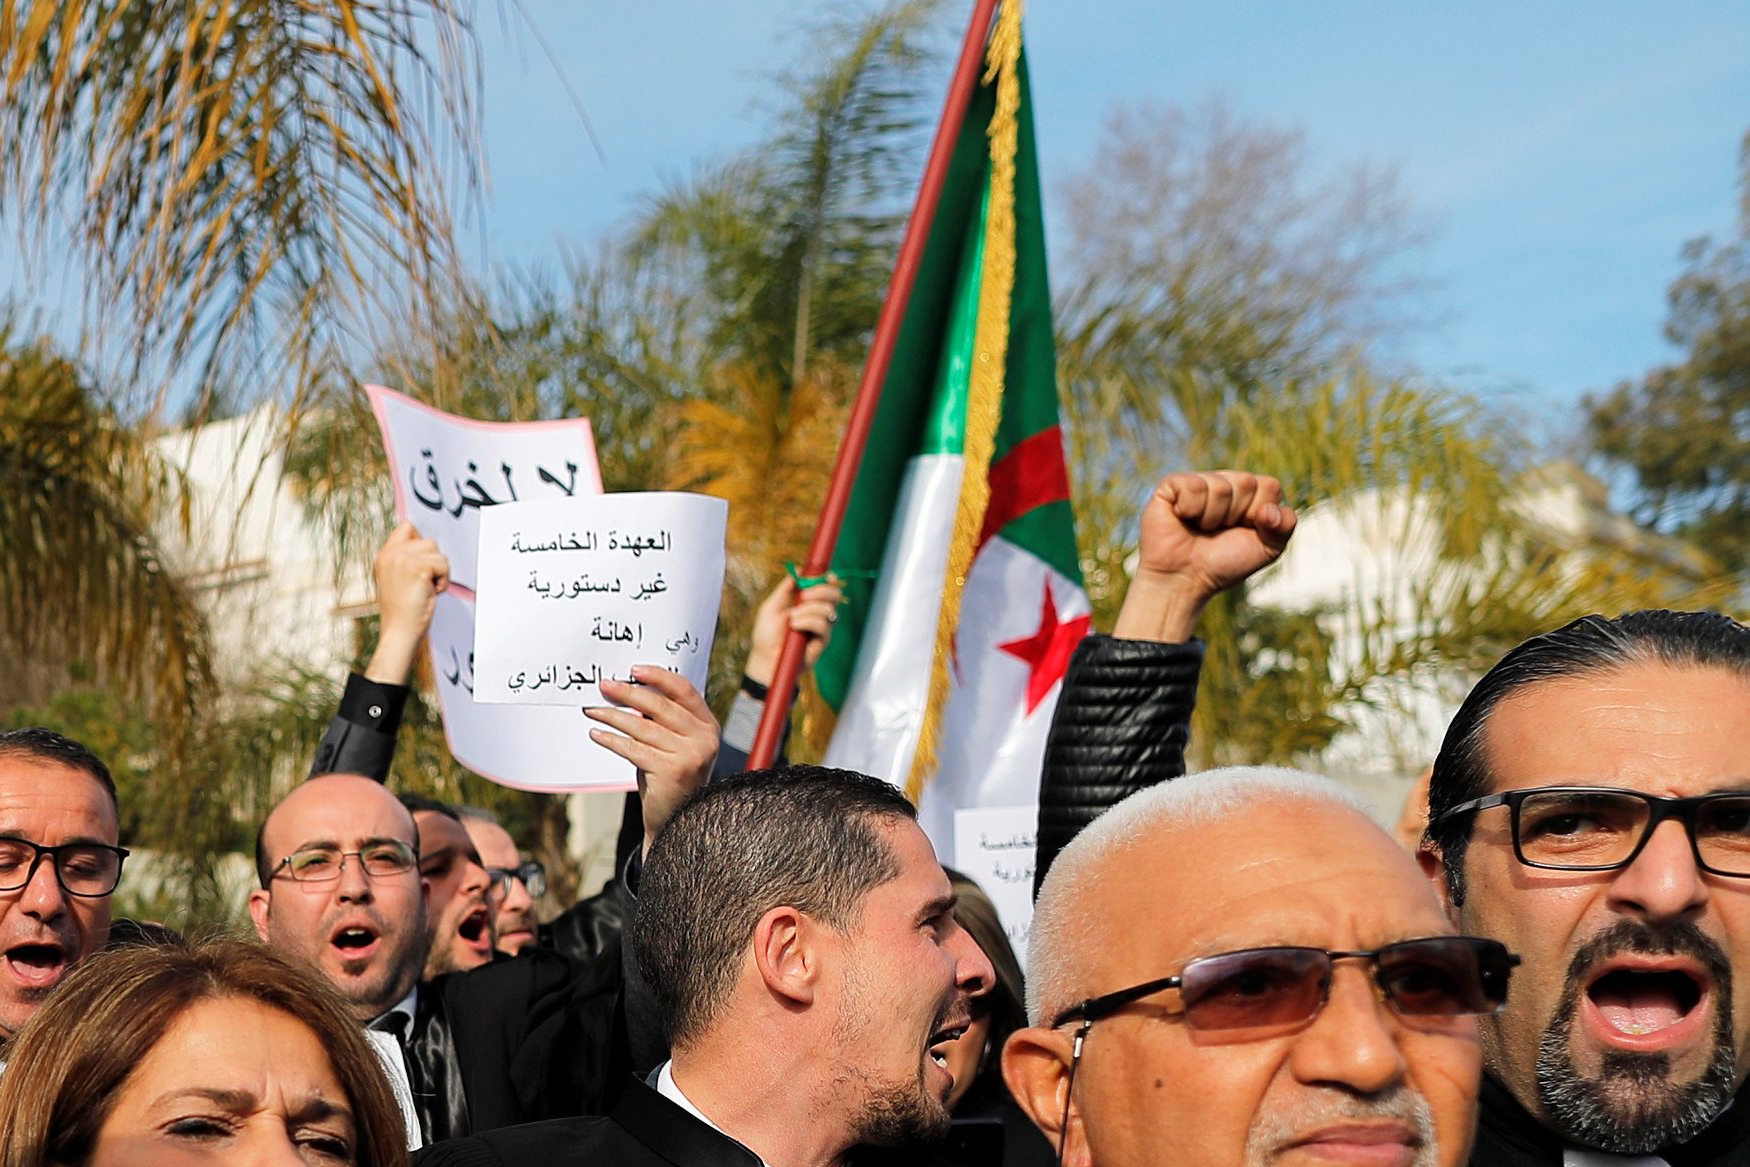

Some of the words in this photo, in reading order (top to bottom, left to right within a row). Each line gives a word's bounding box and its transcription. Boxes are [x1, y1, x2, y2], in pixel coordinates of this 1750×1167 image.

[538, 460, 578, 497] لا
[511, 531, 597, 553] الخامسة
[608, 530, 671, 557] العهدة
[527, 570, 621, 600] دستورية
[629, 572, 668, 600] غير
[591, 616, 643, 649] إهانة
[508, 664, 602, 693] الجزائري
